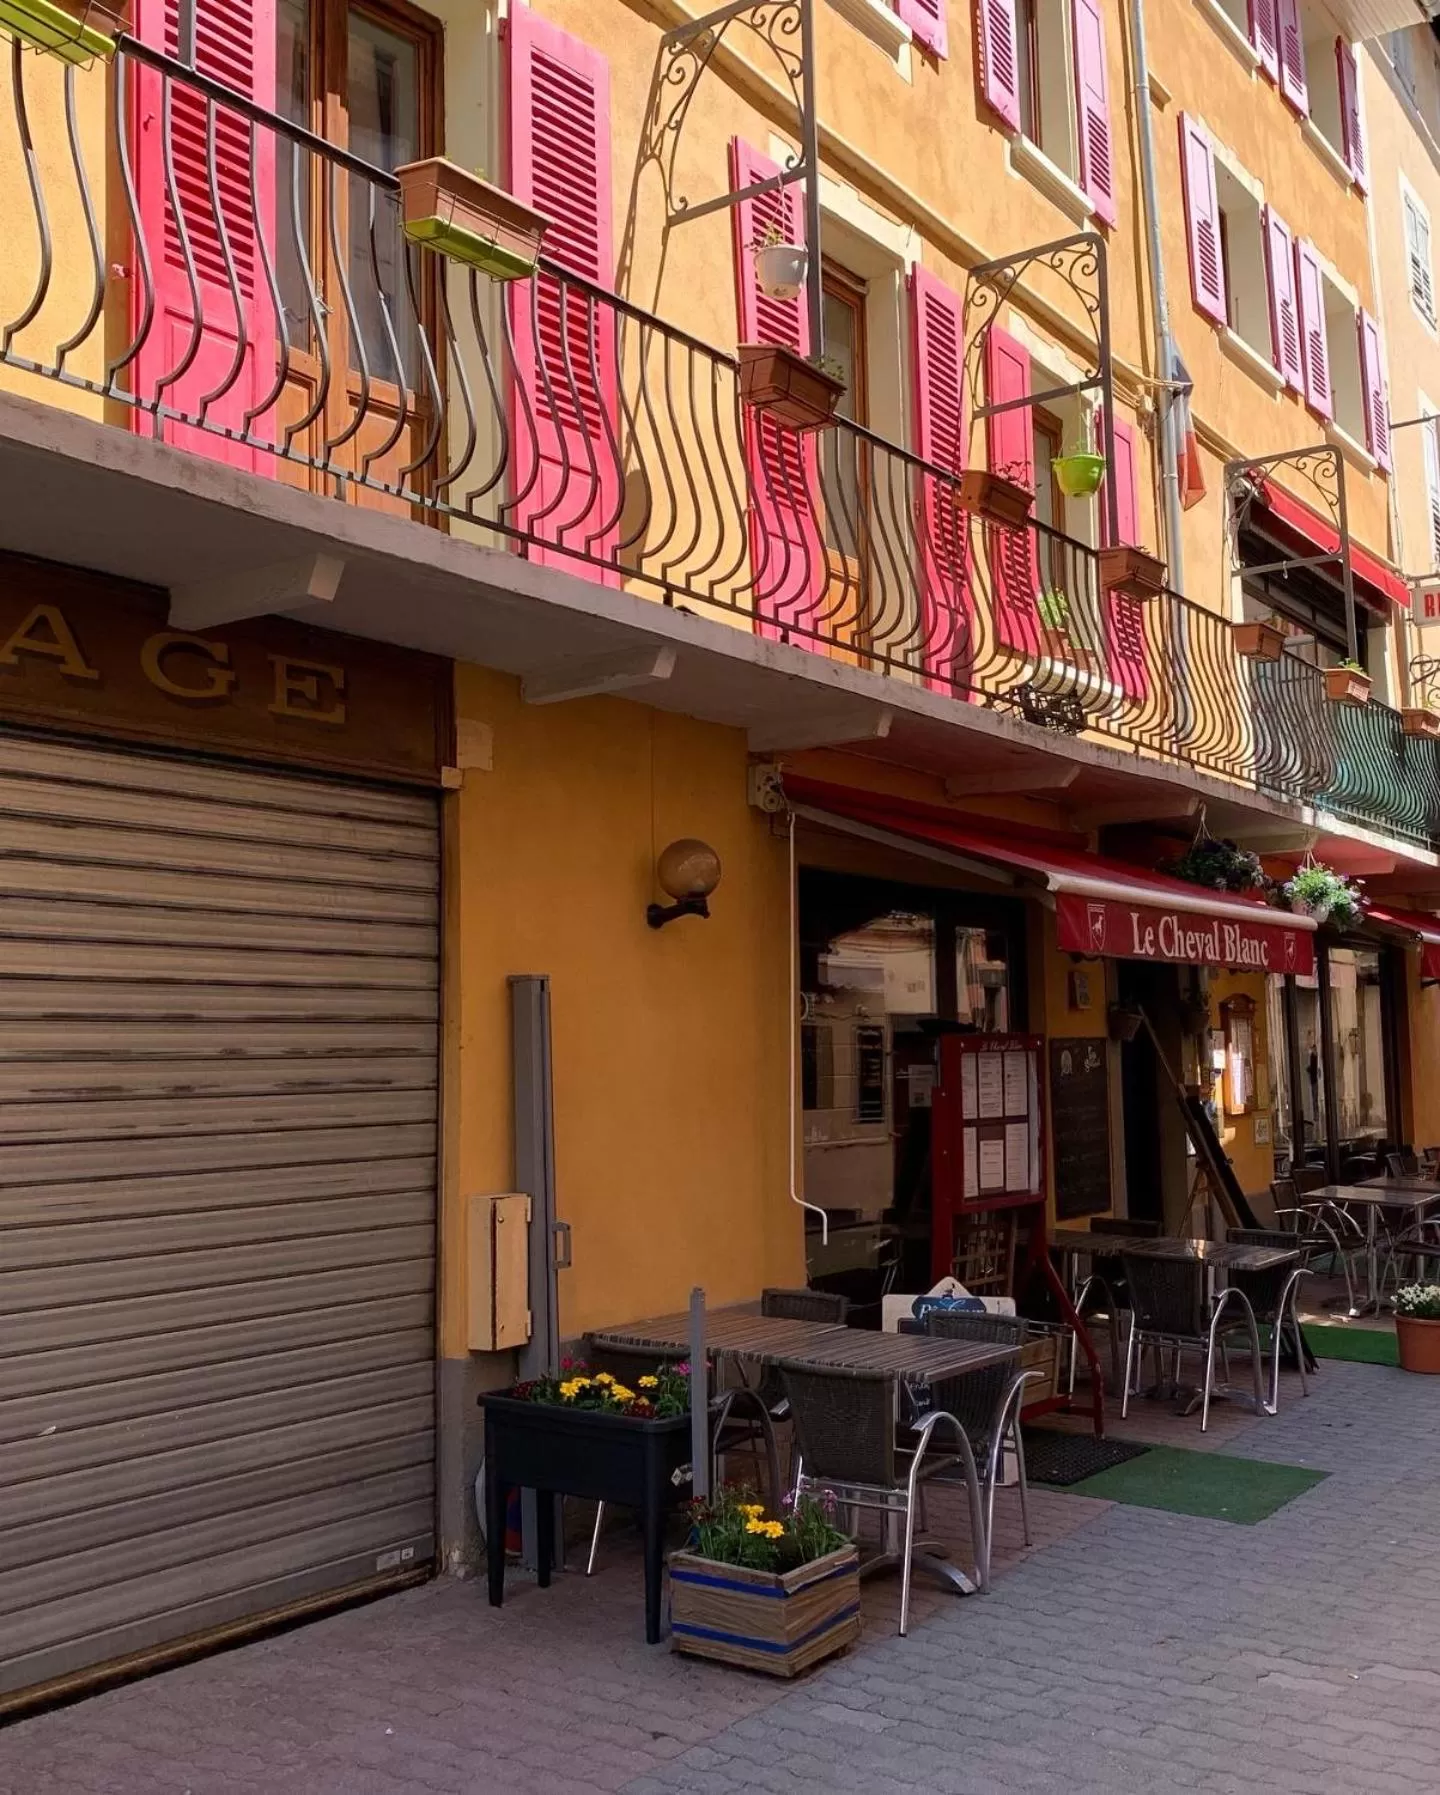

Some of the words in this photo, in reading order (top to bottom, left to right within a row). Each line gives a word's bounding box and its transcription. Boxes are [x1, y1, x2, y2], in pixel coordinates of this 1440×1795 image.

[0, 604, 345, 724] AGE
[1130, 912, 1155, 955] Le
[1158, 915, 1220, 961] Cheval
[1223, 924, 1269, 966] Blanc
